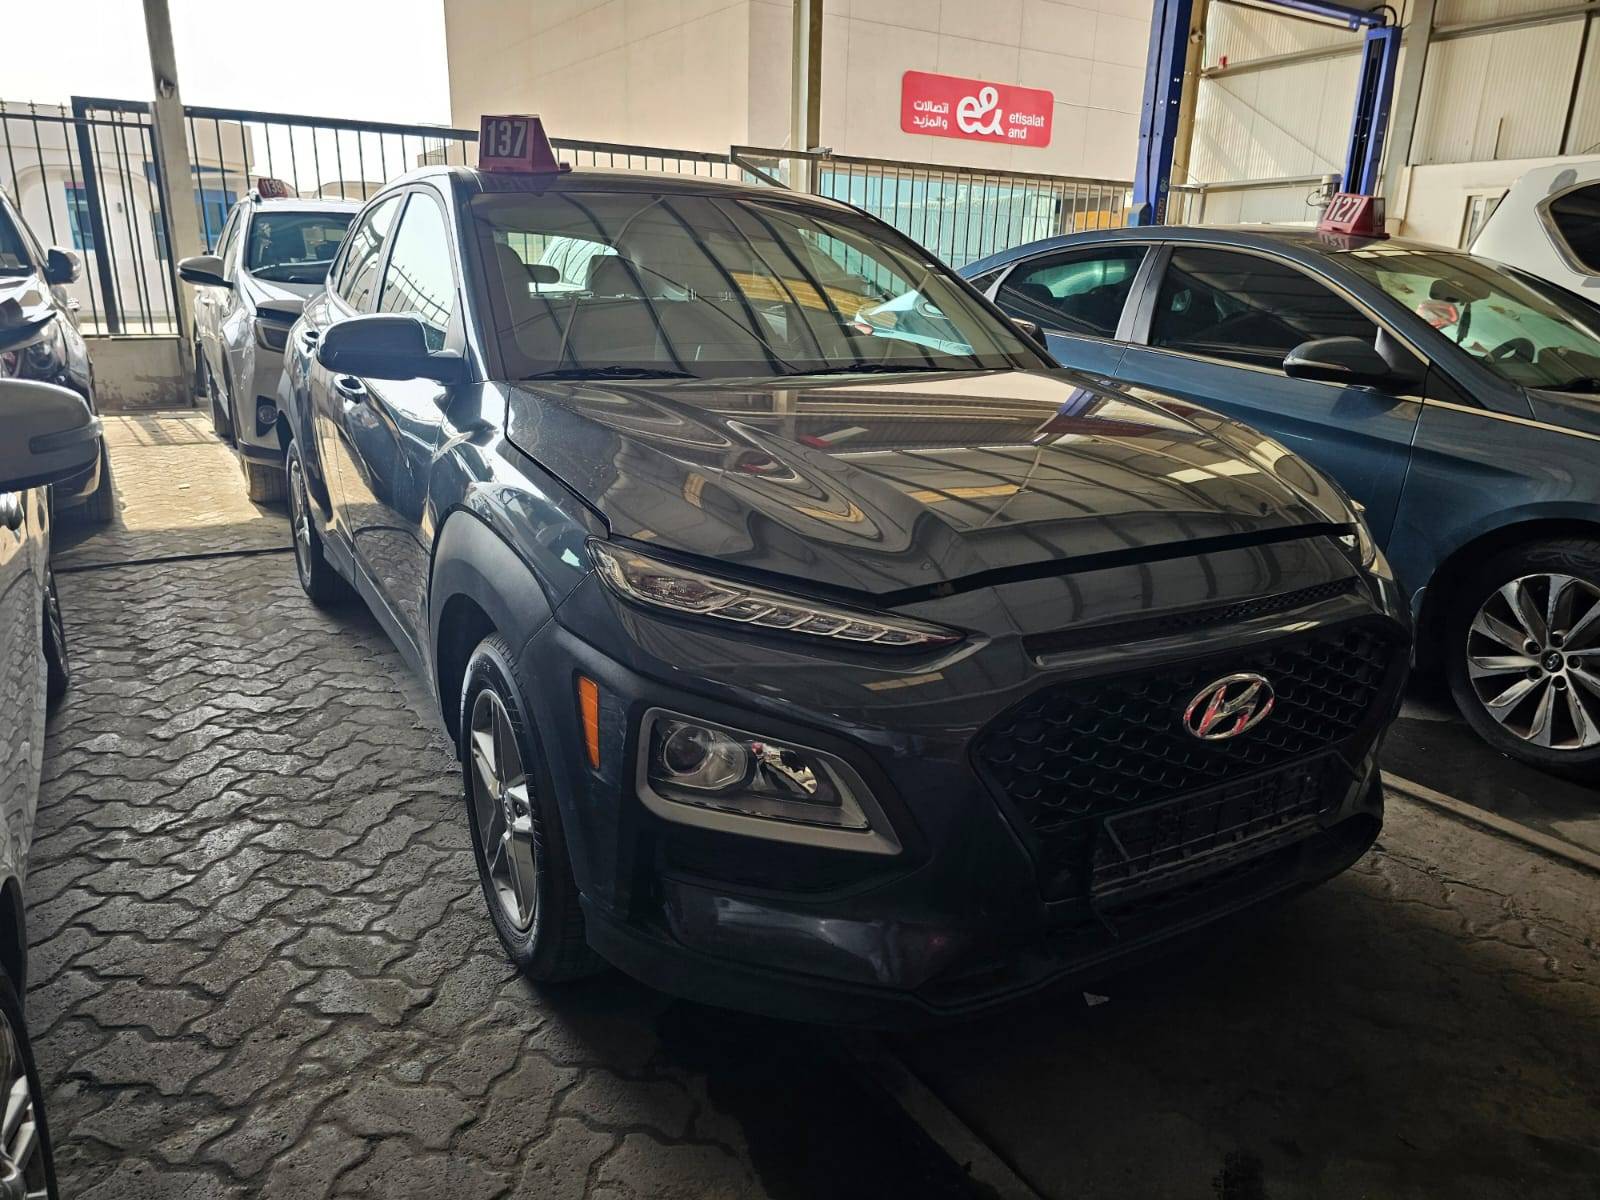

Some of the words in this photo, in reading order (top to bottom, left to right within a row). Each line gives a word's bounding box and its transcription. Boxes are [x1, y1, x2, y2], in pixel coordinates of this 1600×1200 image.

[913, 100, 949, 114] اتصالات
[913, 115, 948, 129] والمزيد
[1009, 113, 1045, 127] etisalat
[487, 120, 527, 157] 137
[1008, 127, 1027, 139] and
[1328, 196, 1362, 222] 127
